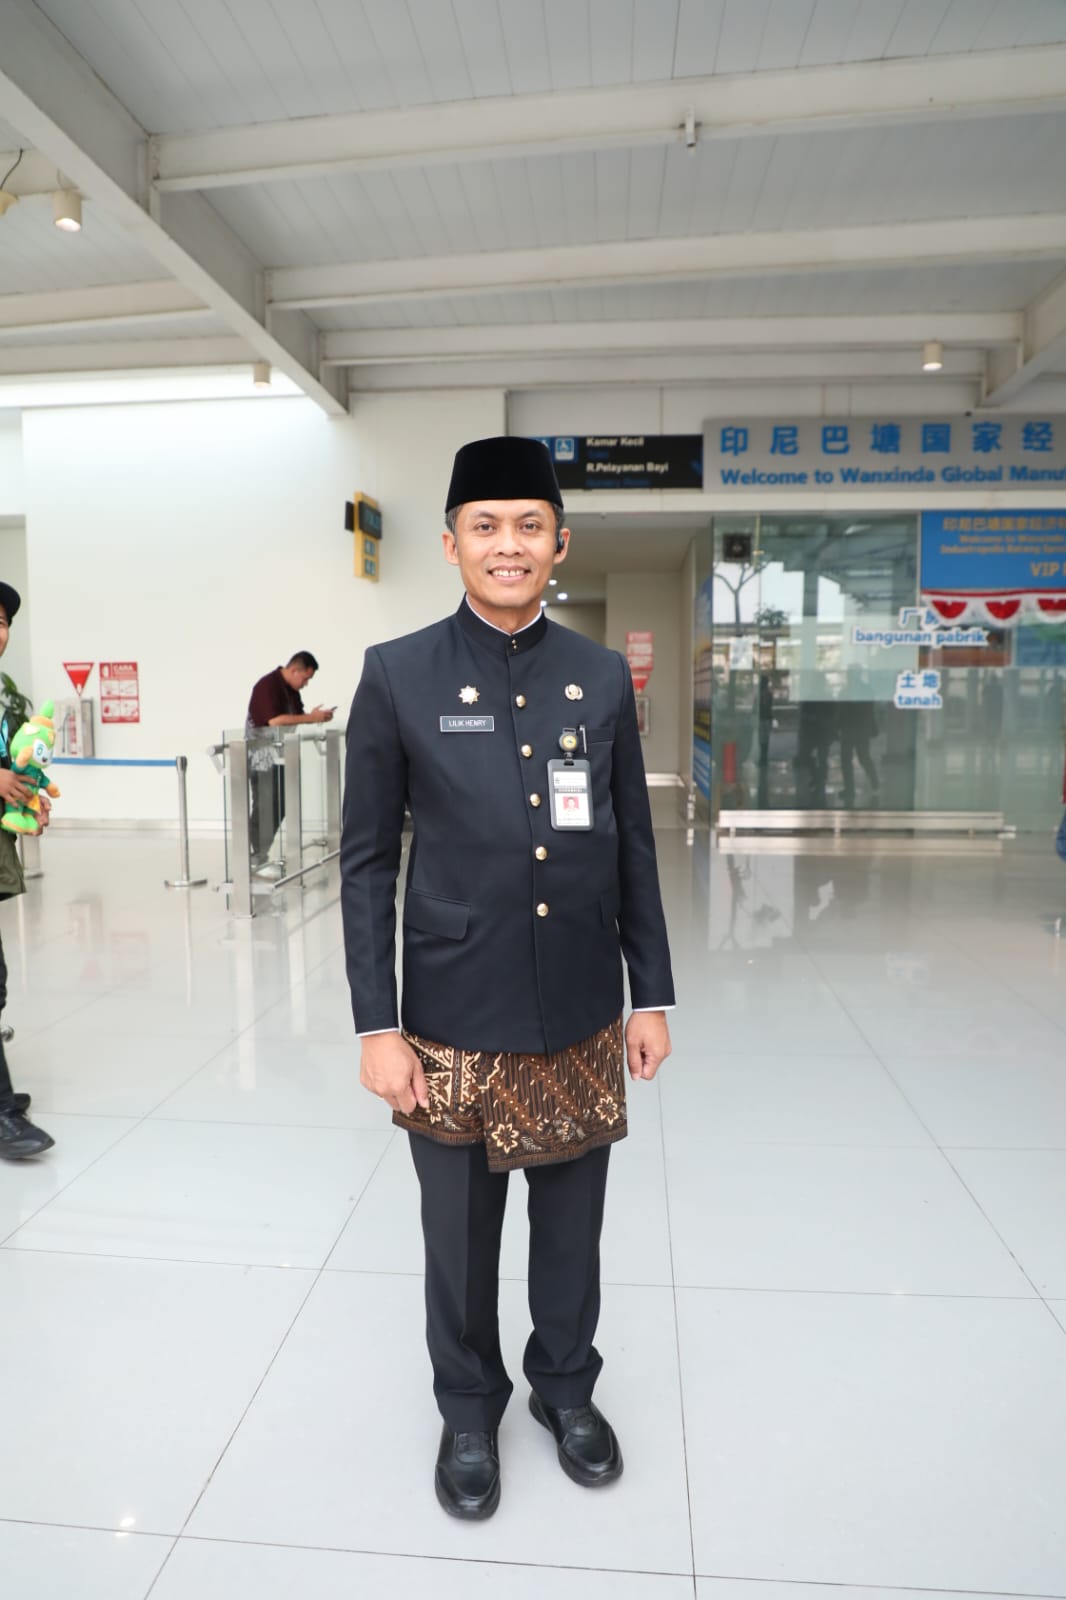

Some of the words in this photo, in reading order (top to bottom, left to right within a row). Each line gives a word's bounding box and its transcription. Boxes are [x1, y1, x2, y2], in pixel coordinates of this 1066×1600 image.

[587, 437, 618, 447] Kamar
[621, 437, 644, 447] Kecil
[720, 421, 1054, 456] 印尼巴塘国家经
[646, 461, 669, 474] Bayi
[720, 467, 808, 485] Welcome
[815, 468, 834, 484] to
[840, 466, 935, 484] Wanxinda
[941, 464, 1003, 483] Global
[1030, 561, 1059, 577] VIP
[856, 629, 931, 645] bangunan
[936, 629, 985, 645] pabrik
[900, 673, 939, 688] 土地
[898, 694, 941, 706] tanah
[448, 719, 464, 727] LILIK
[465, 719, 487, 727] HENRY
